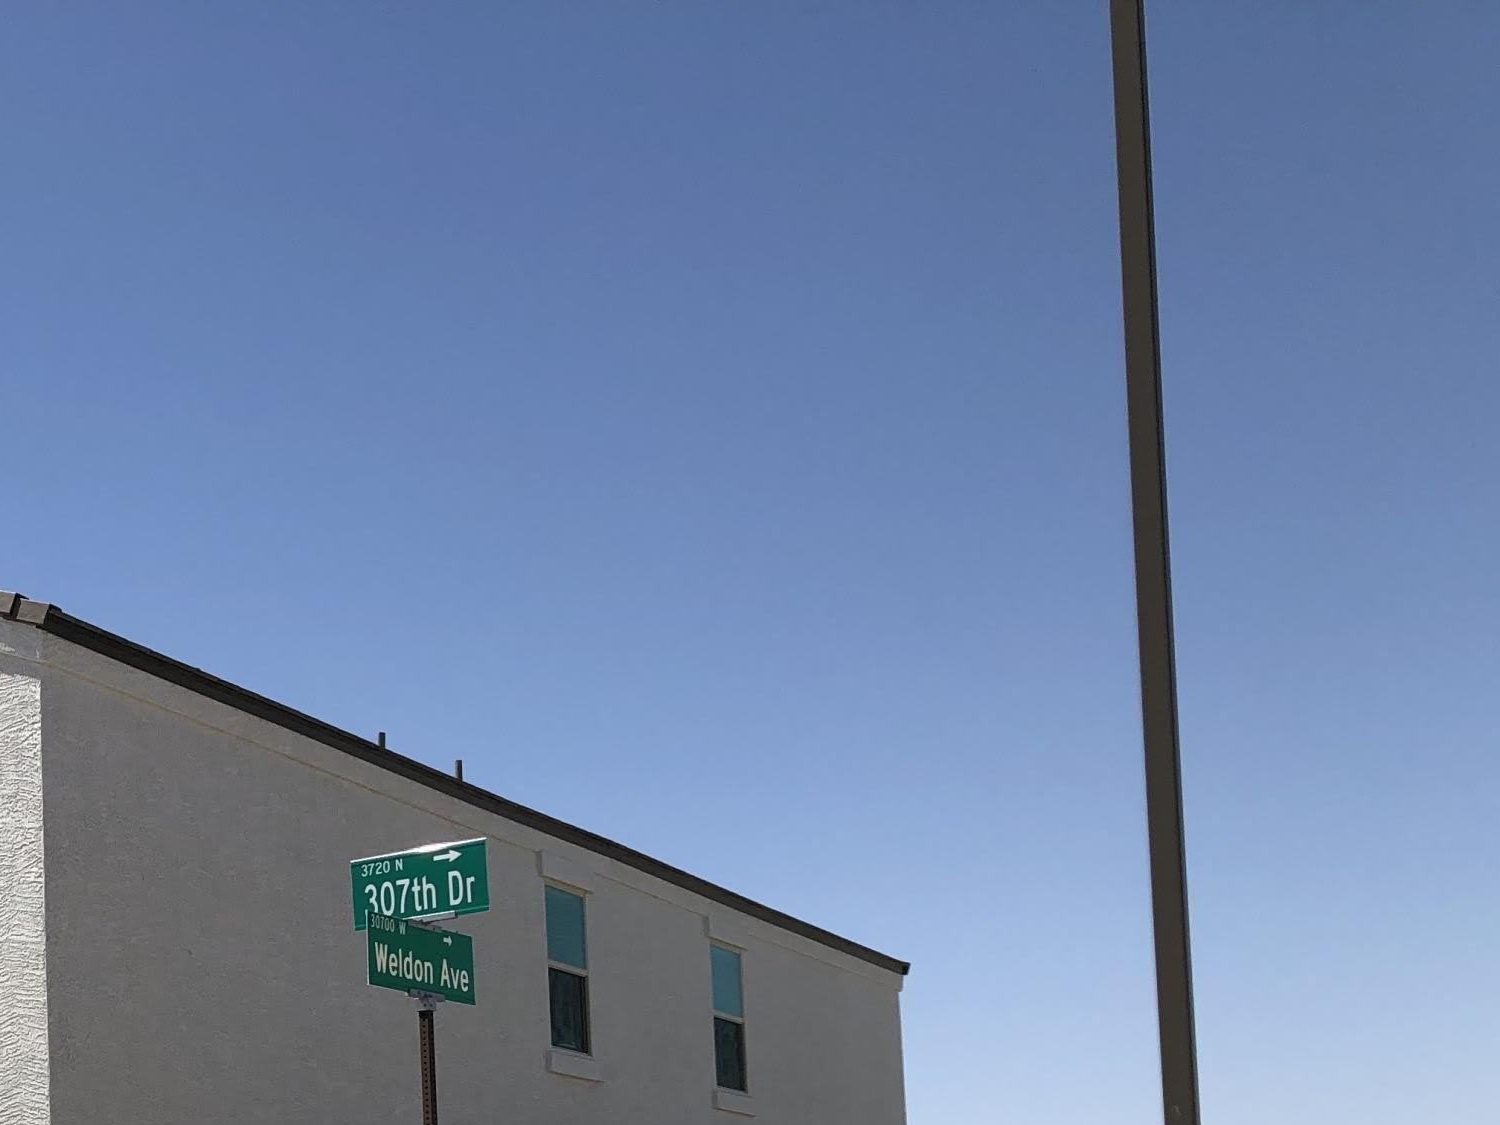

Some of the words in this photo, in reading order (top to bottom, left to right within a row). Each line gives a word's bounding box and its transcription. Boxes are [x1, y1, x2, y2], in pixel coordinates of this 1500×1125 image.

[361, 861, 390, 877] 3720
[395, 859, 403, 872] N
[364, 875, 437, 916] 307th
[448, 870, 475, 906] Dr
[371, 914, 395, 932] 30700
[398, 921, 407, 935] W
[375, 942, 434, 984] Weldon
[440, 959, 469, 992] Ave
